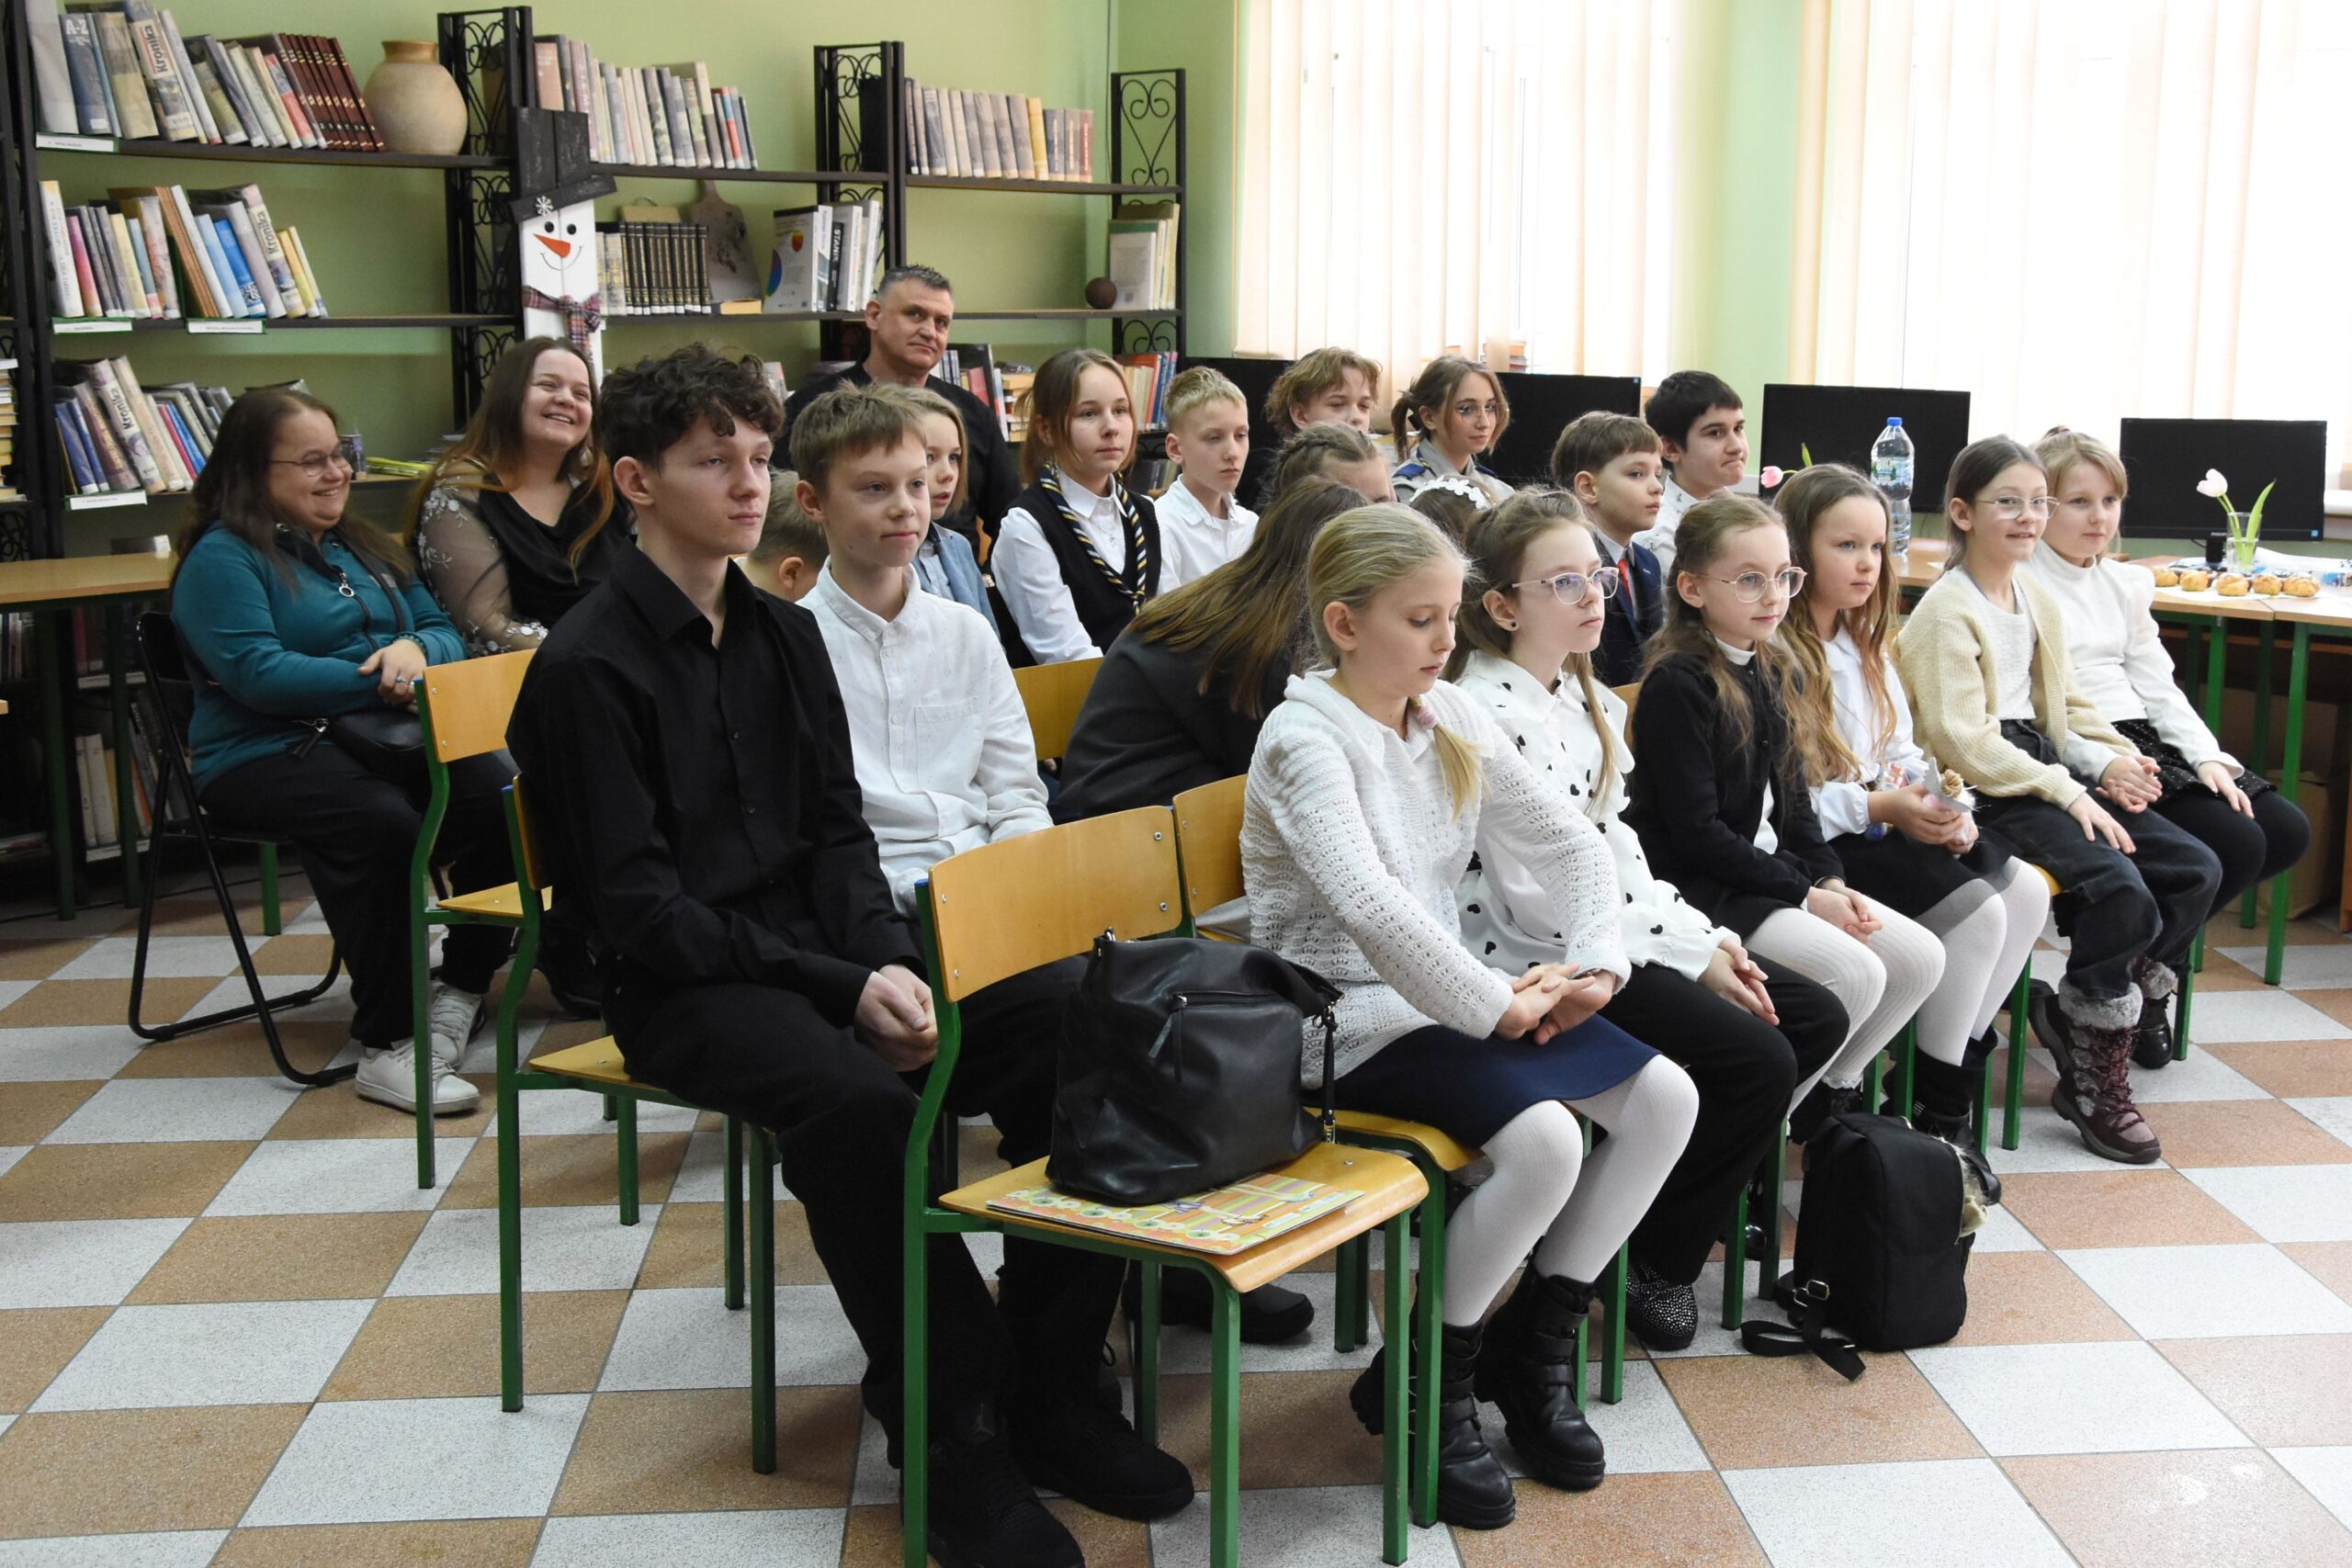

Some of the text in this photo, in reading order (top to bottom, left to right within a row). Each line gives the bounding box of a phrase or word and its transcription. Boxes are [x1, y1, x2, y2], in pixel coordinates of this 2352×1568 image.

[65, 19, 89, 35] A-Z
[144, 25, 168, 73] Kronika
[256, 210, 279, 255] Kronika
[109, 388, 134, 430] Kronika
